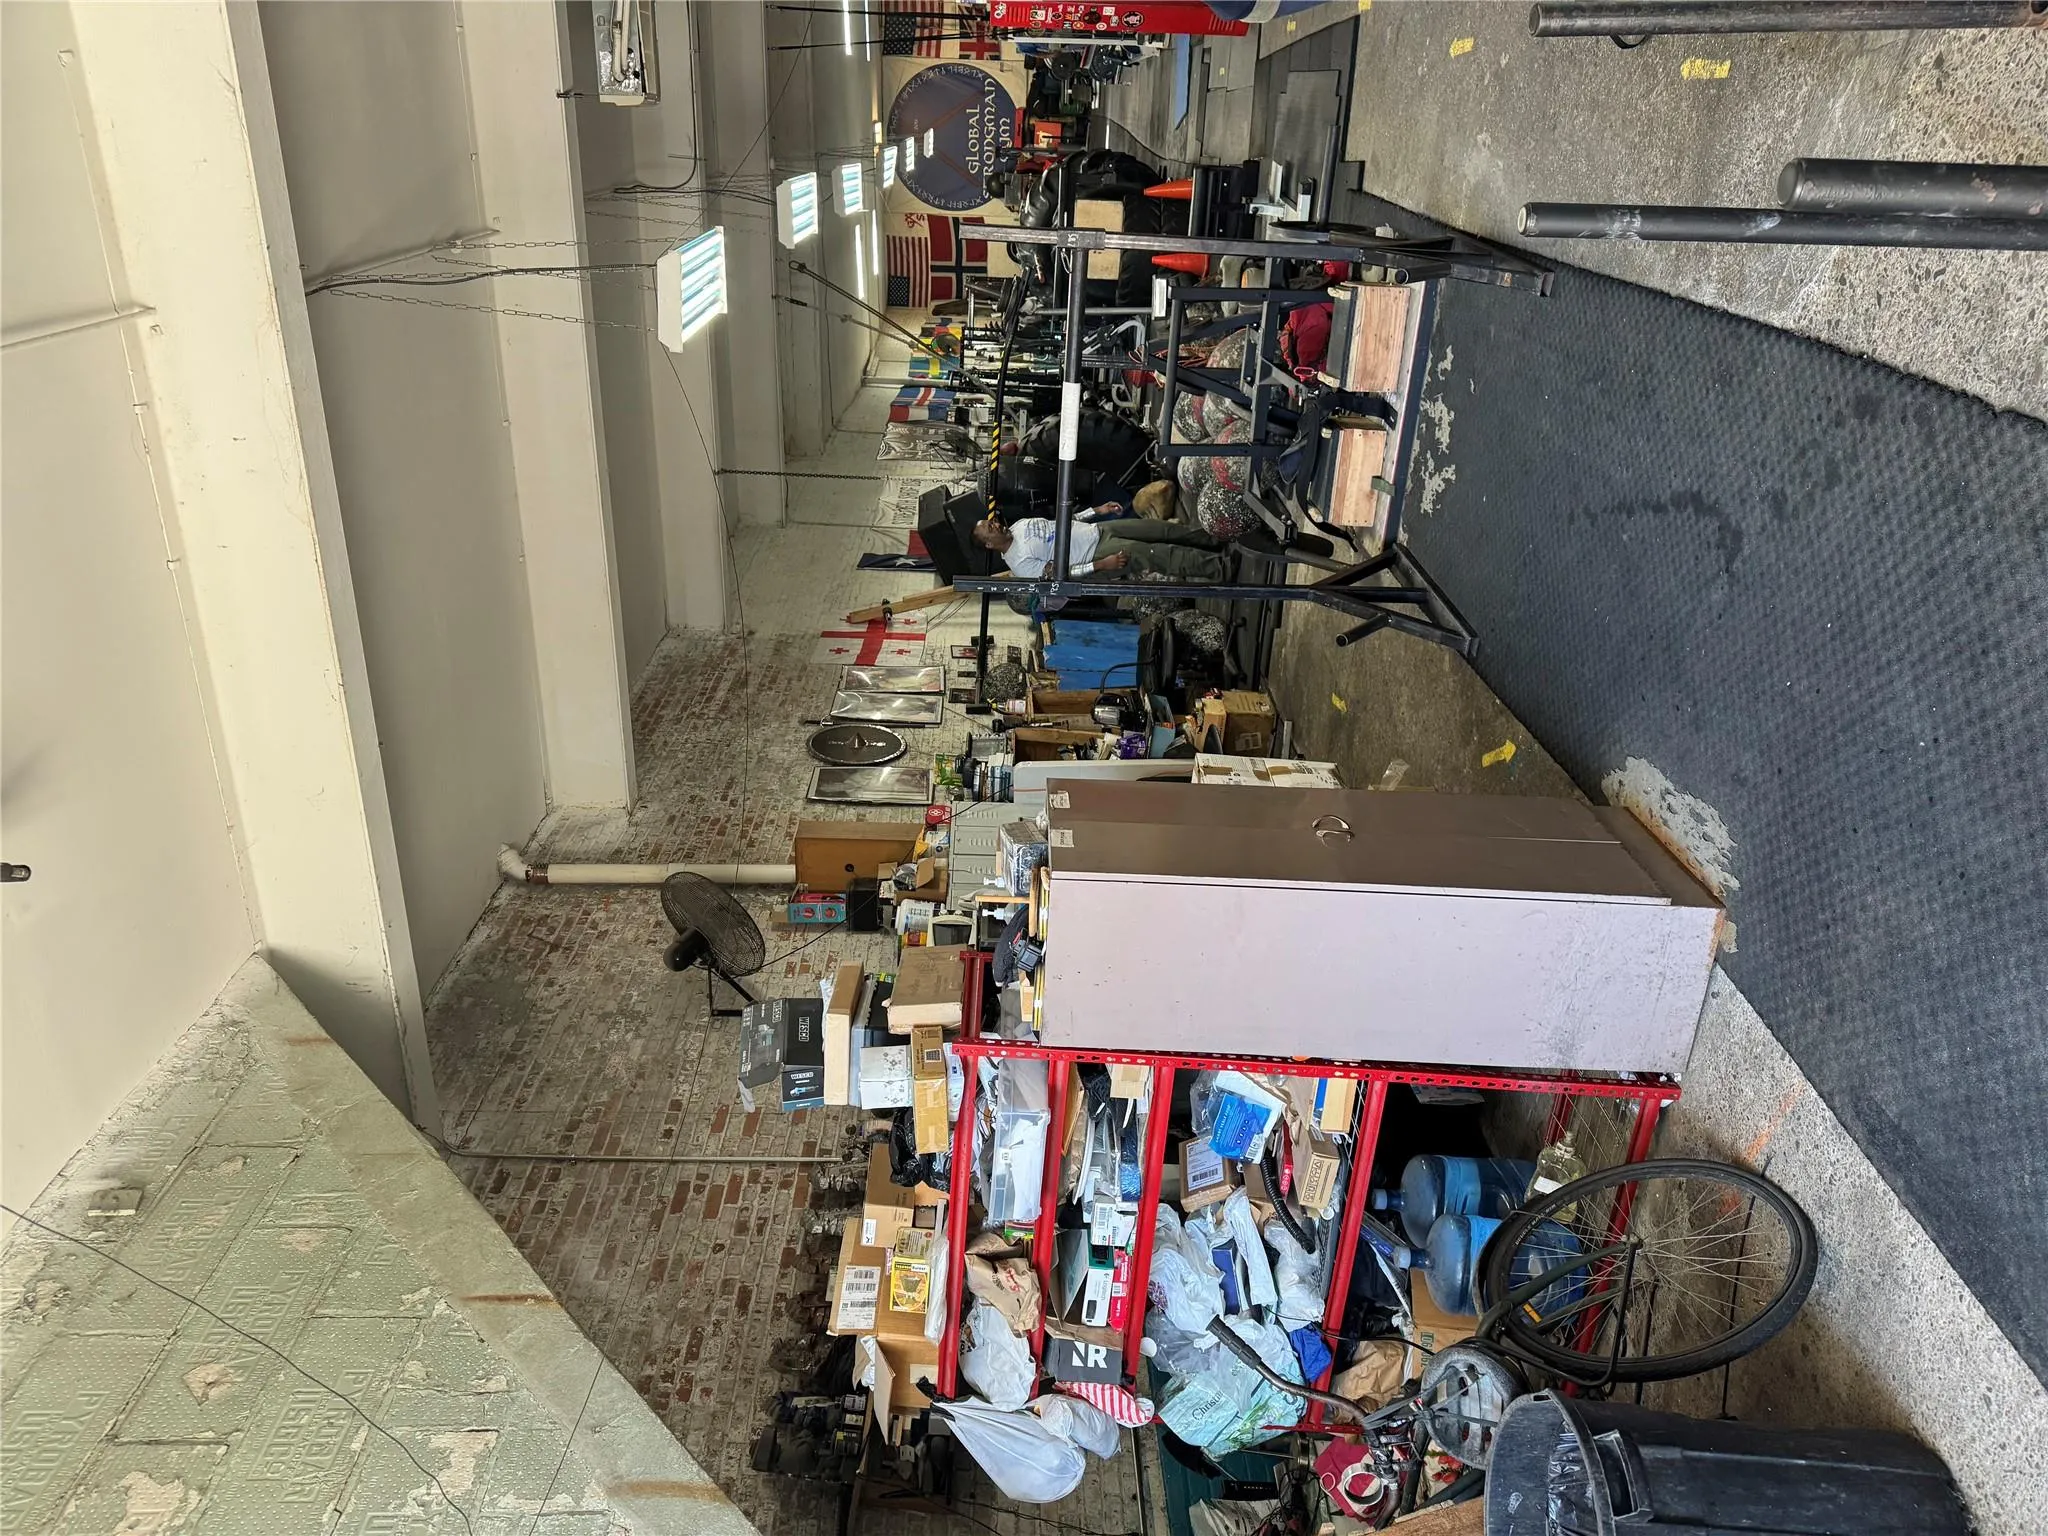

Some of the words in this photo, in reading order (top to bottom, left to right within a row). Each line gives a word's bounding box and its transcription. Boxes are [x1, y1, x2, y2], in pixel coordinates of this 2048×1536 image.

[965, 104, 980, 174] GLOBAL
[798, 1016, 810, 1042] WESCO
[1072, 1341, 1107, 1368] NR
